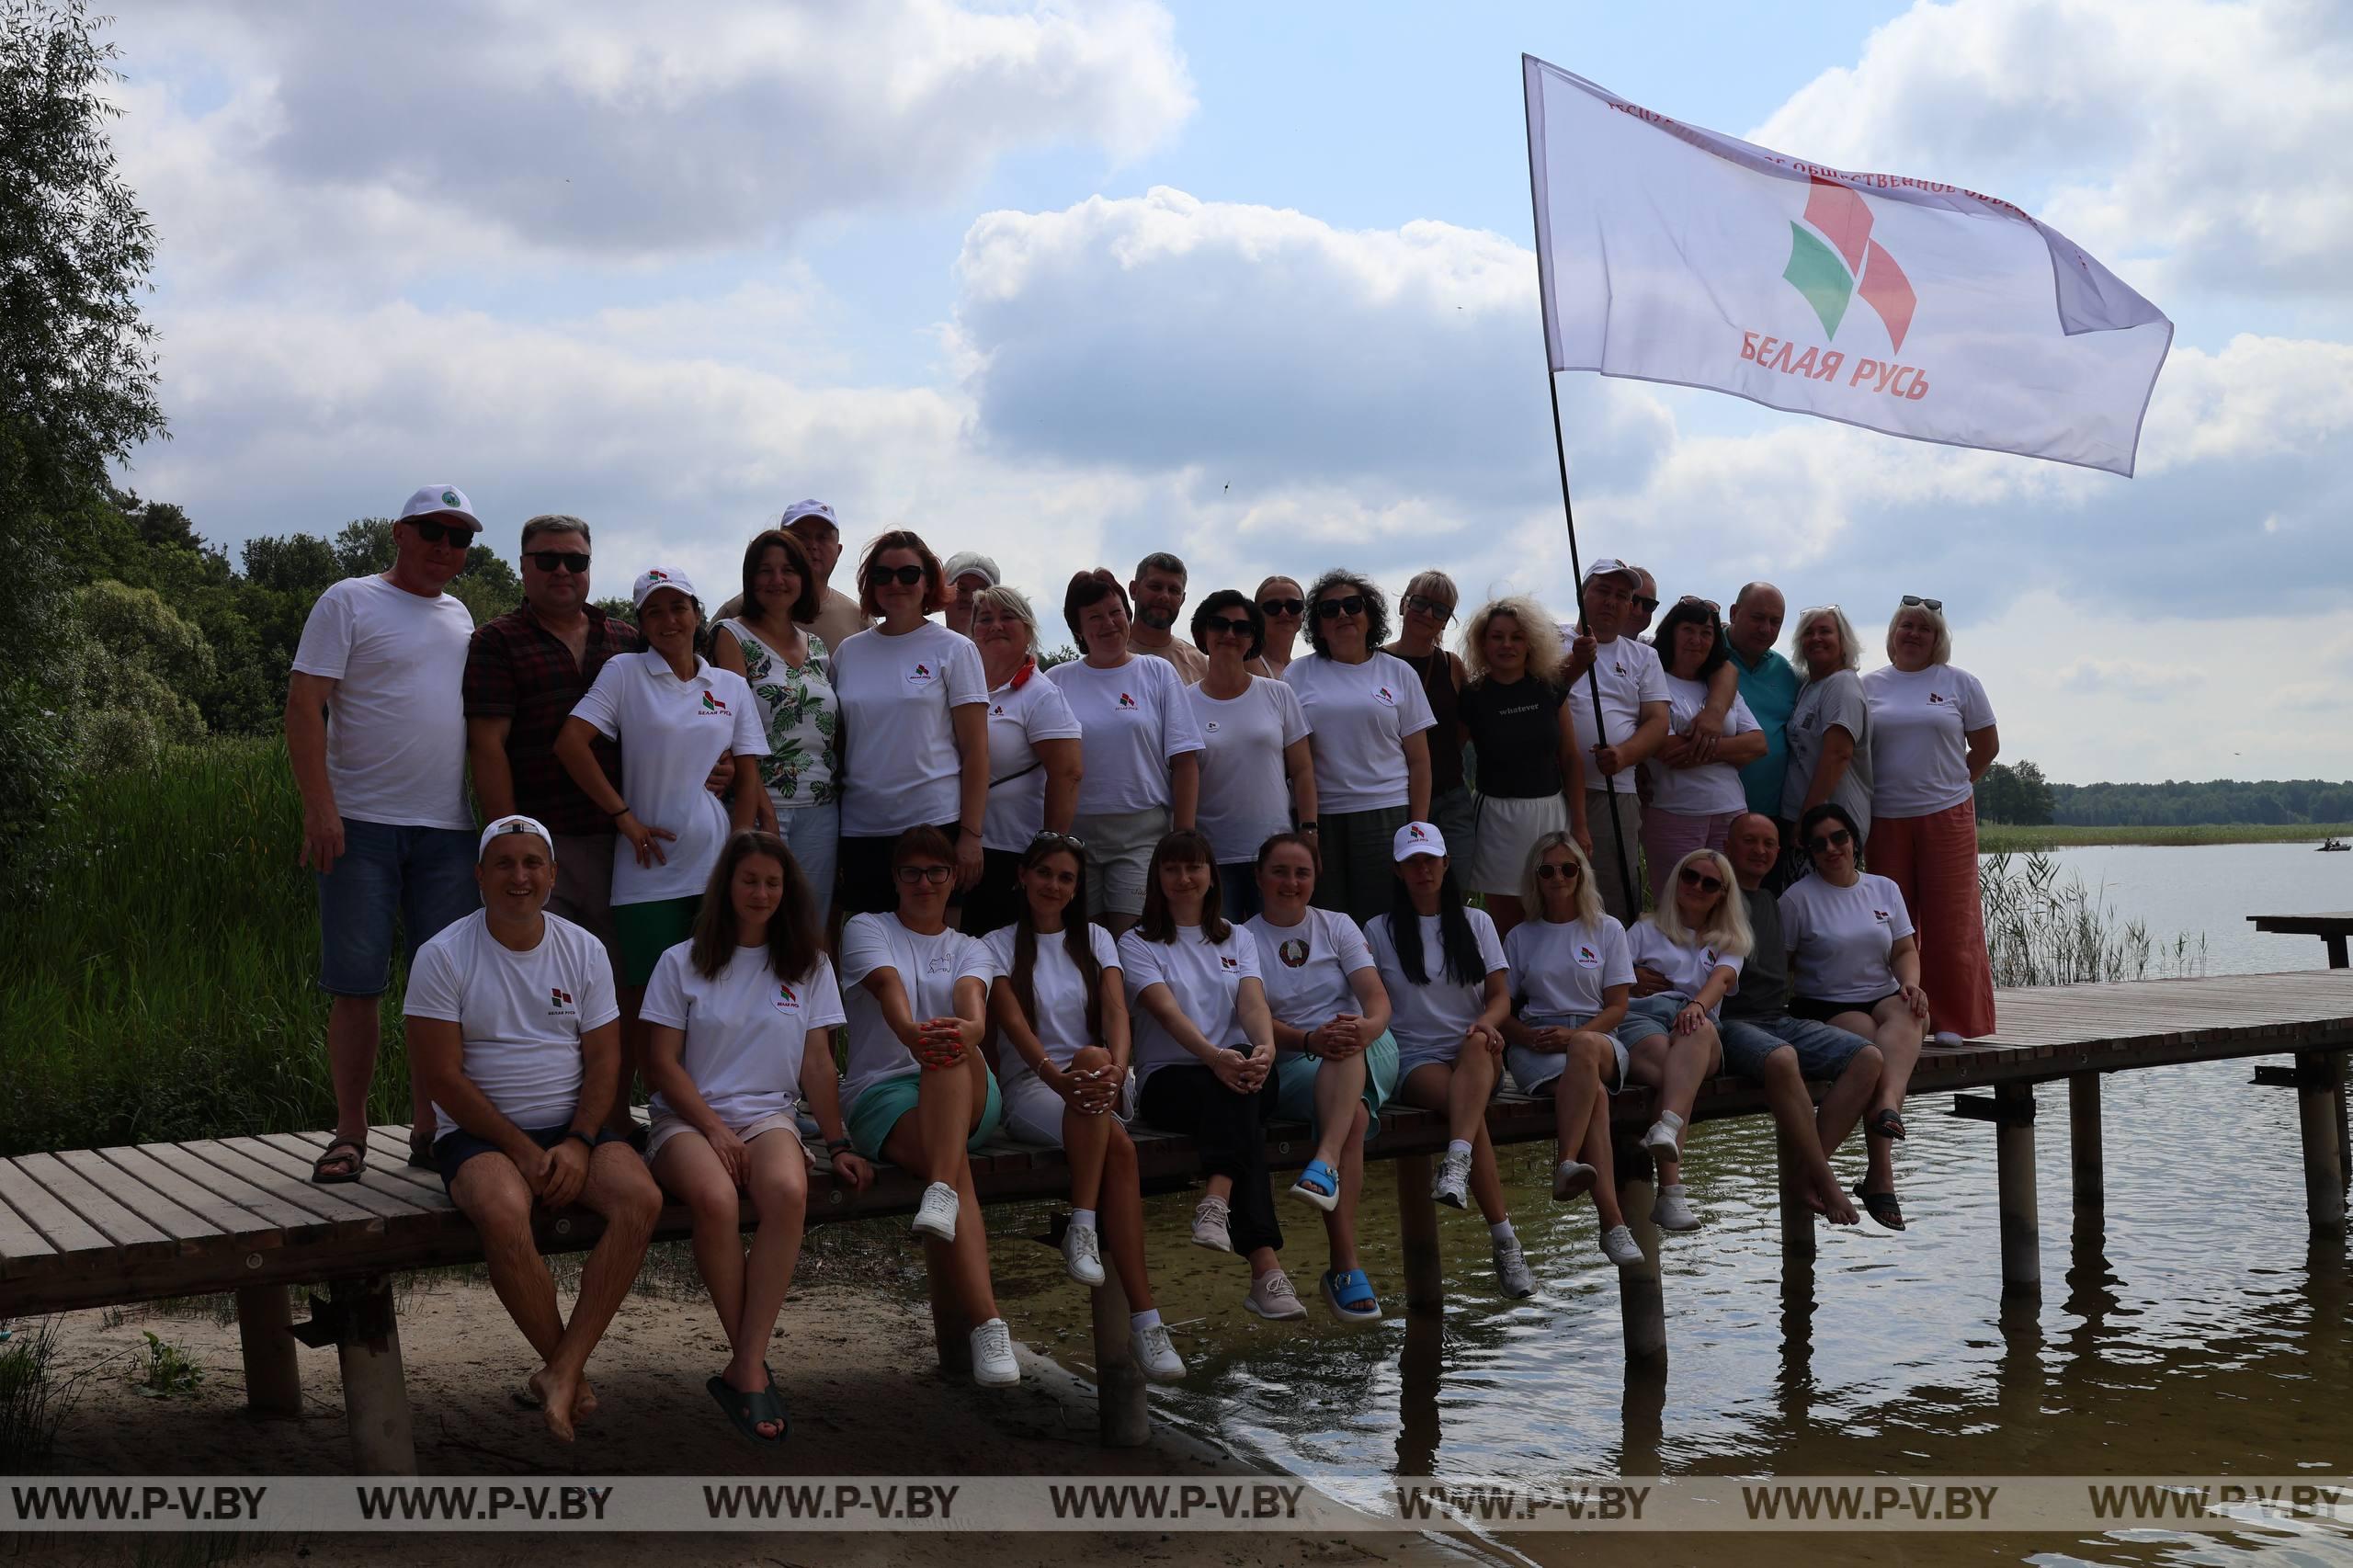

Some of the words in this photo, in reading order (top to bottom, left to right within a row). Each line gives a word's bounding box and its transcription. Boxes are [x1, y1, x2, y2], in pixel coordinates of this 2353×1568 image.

[1740, 330, 1846, 382] БЕЛАЯ
[1849, 358, 1930, 401] РУСЬ
[1499, 703, 1539, 715] whatever
